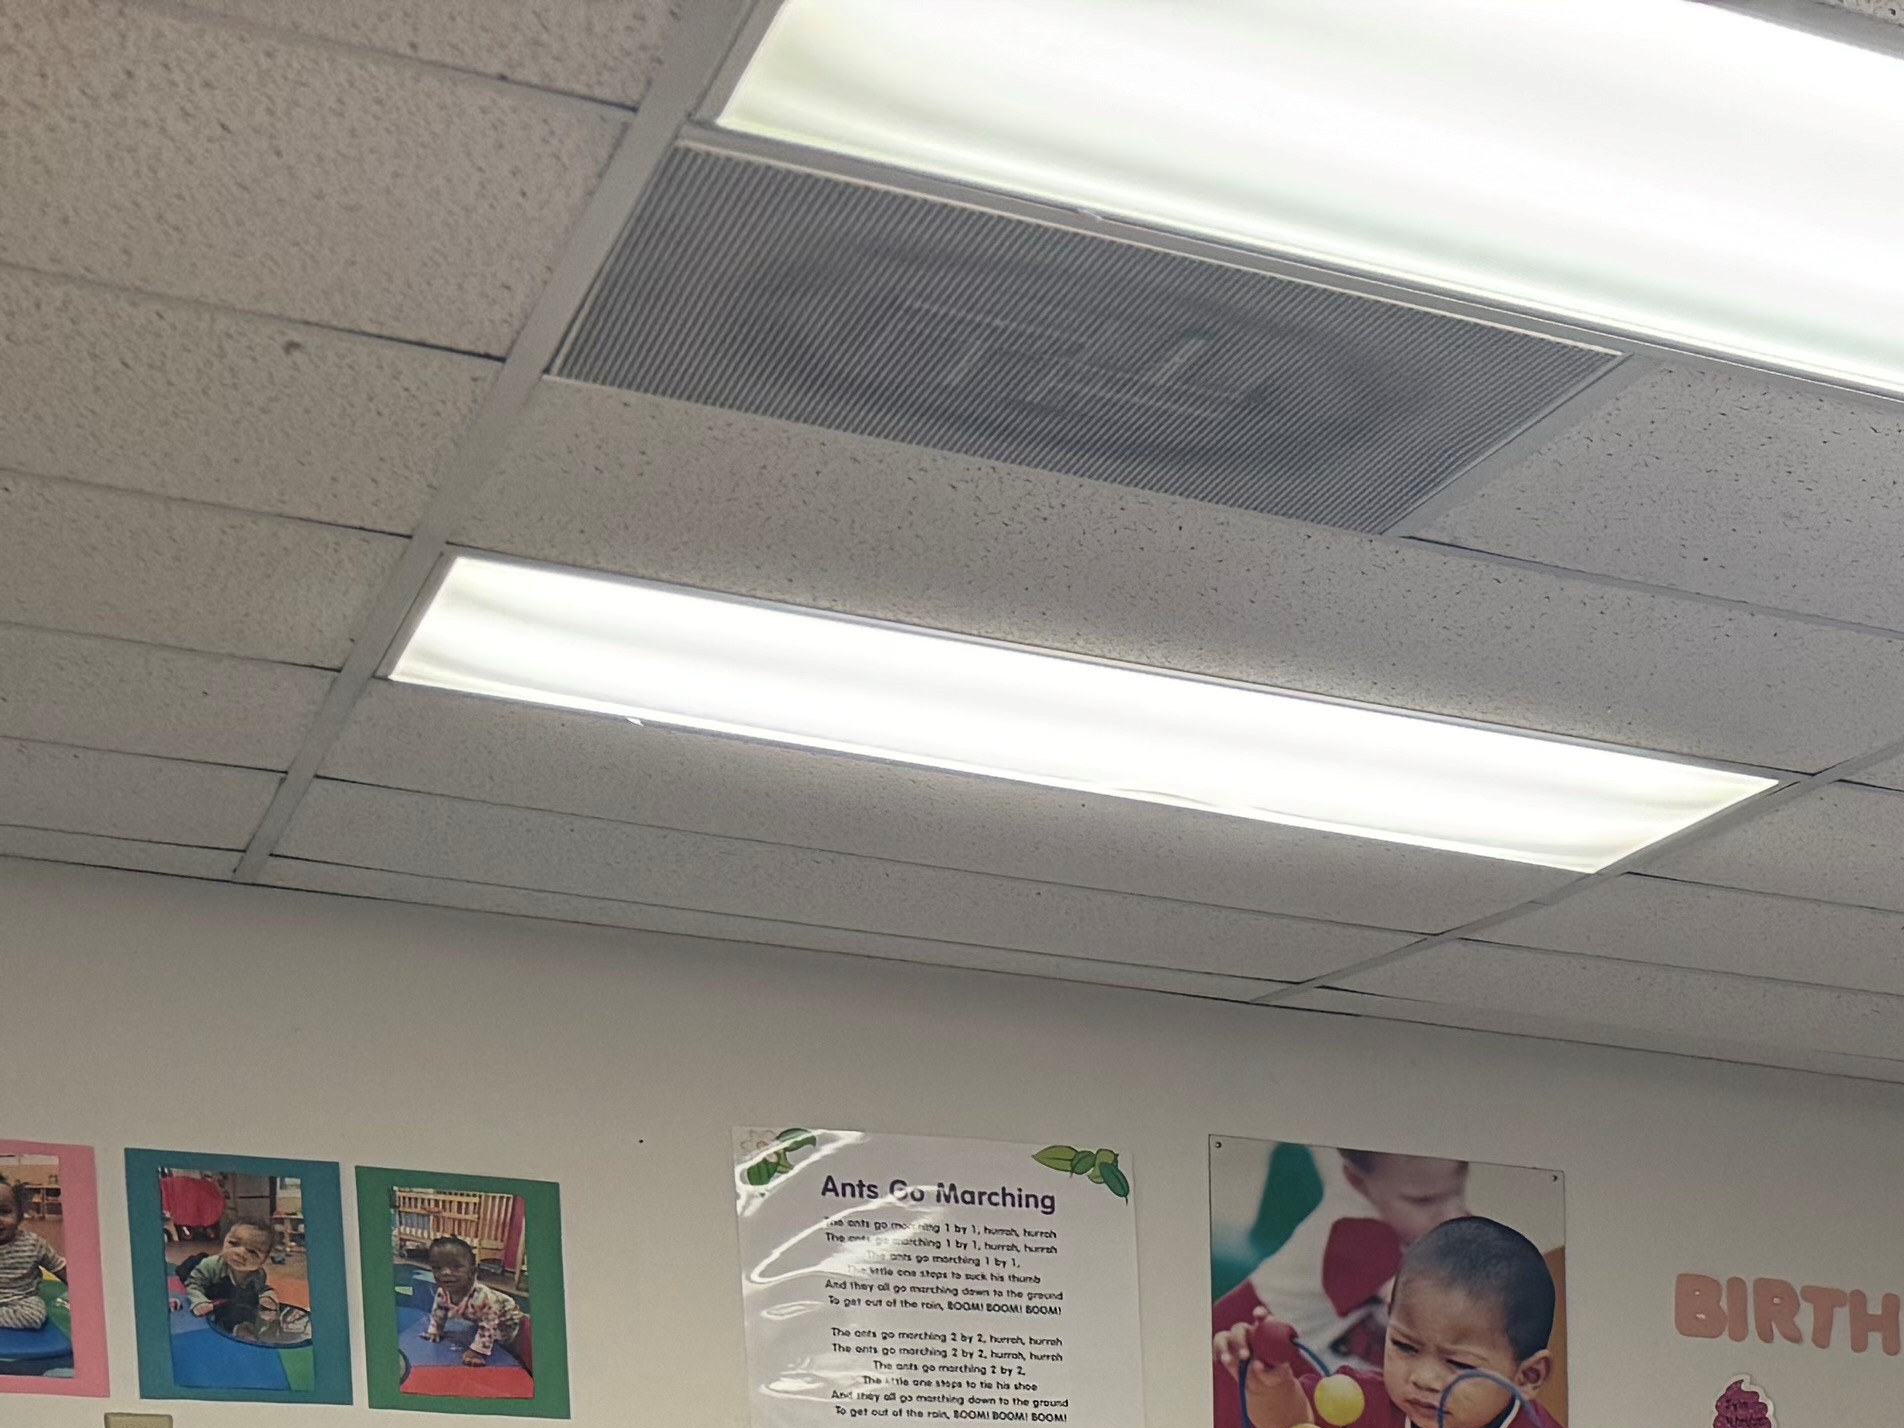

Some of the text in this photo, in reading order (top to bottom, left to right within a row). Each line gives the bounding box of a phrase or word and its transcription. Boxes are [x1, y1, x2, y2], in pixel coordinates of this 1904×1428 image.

[821, 1175, 1056, 1215] Ants Go Marching
